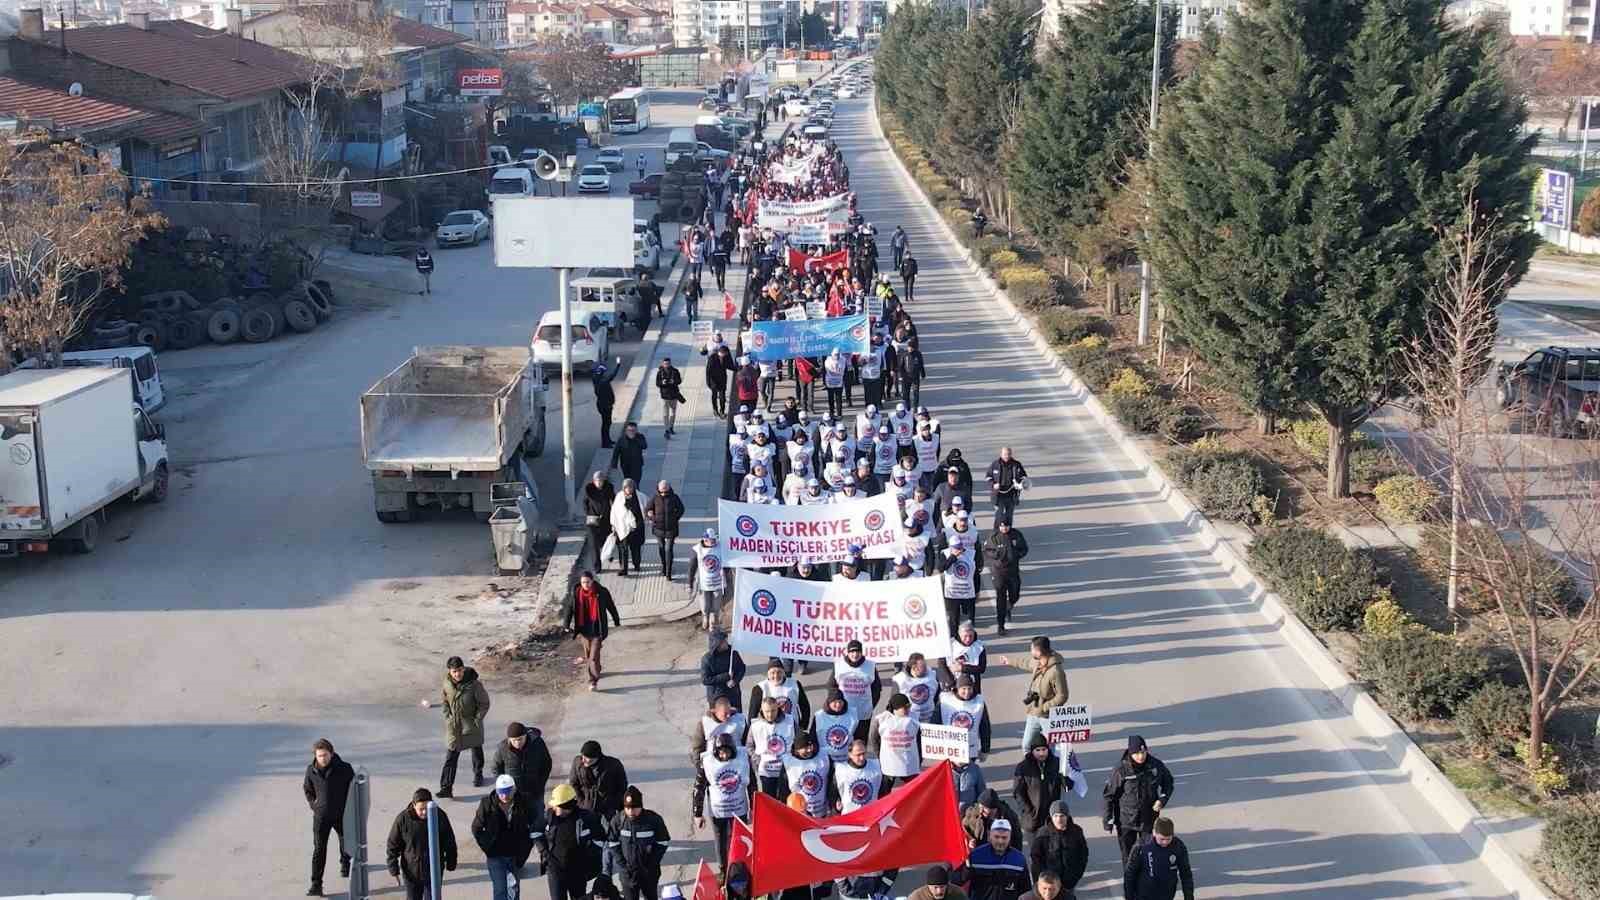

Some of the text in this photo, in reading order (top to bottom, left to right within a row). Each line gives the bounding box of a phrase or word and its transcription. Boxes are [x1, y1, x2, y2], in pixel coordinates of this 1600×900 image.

[770, 519, 851, 537] TÜRKİYE
[730, 537, 773, 553] MADEN
[792, 599, 888, 620] TÜRKİYE
[743, 614, 792, 638] MADEN
[863, 621, 938, 642] SENDİKASI
[1055, 705, 1087, 716] VARLIK
[1050, 717, 1089, 729] SATIŞINA
[1051, 730, 1086, 743] HAYIR
[925, 745, 944, 755] DUR
[947, 747, 960, 757] DE
